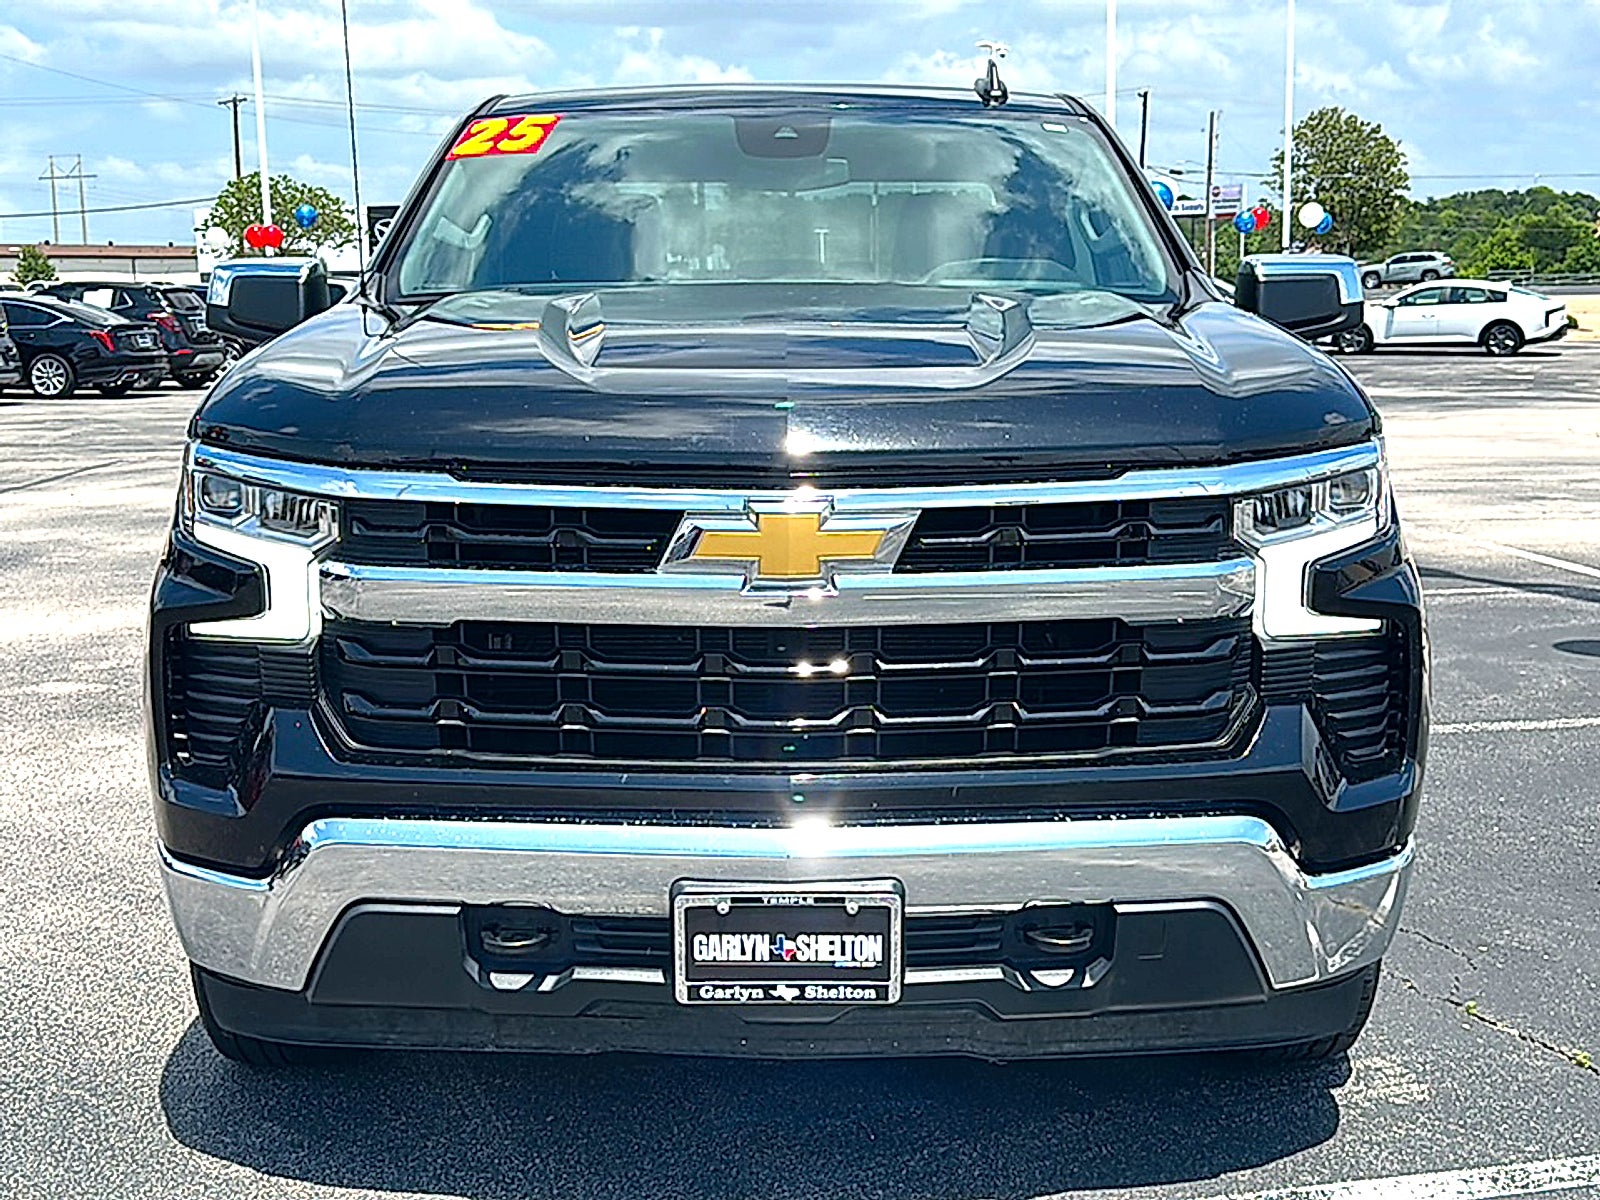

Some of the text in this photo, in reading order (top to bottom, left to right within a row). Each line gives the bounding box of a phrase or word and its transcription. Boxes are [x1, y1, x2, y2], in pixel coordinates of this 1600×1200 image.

[452, 115, 557, 155] 25
[761, 896, 814, 905] TEMPLE
[692, 933, 883, 962] GARLYN SHELTON
[699, 984, 877, 1002] Garlyn Shelton
